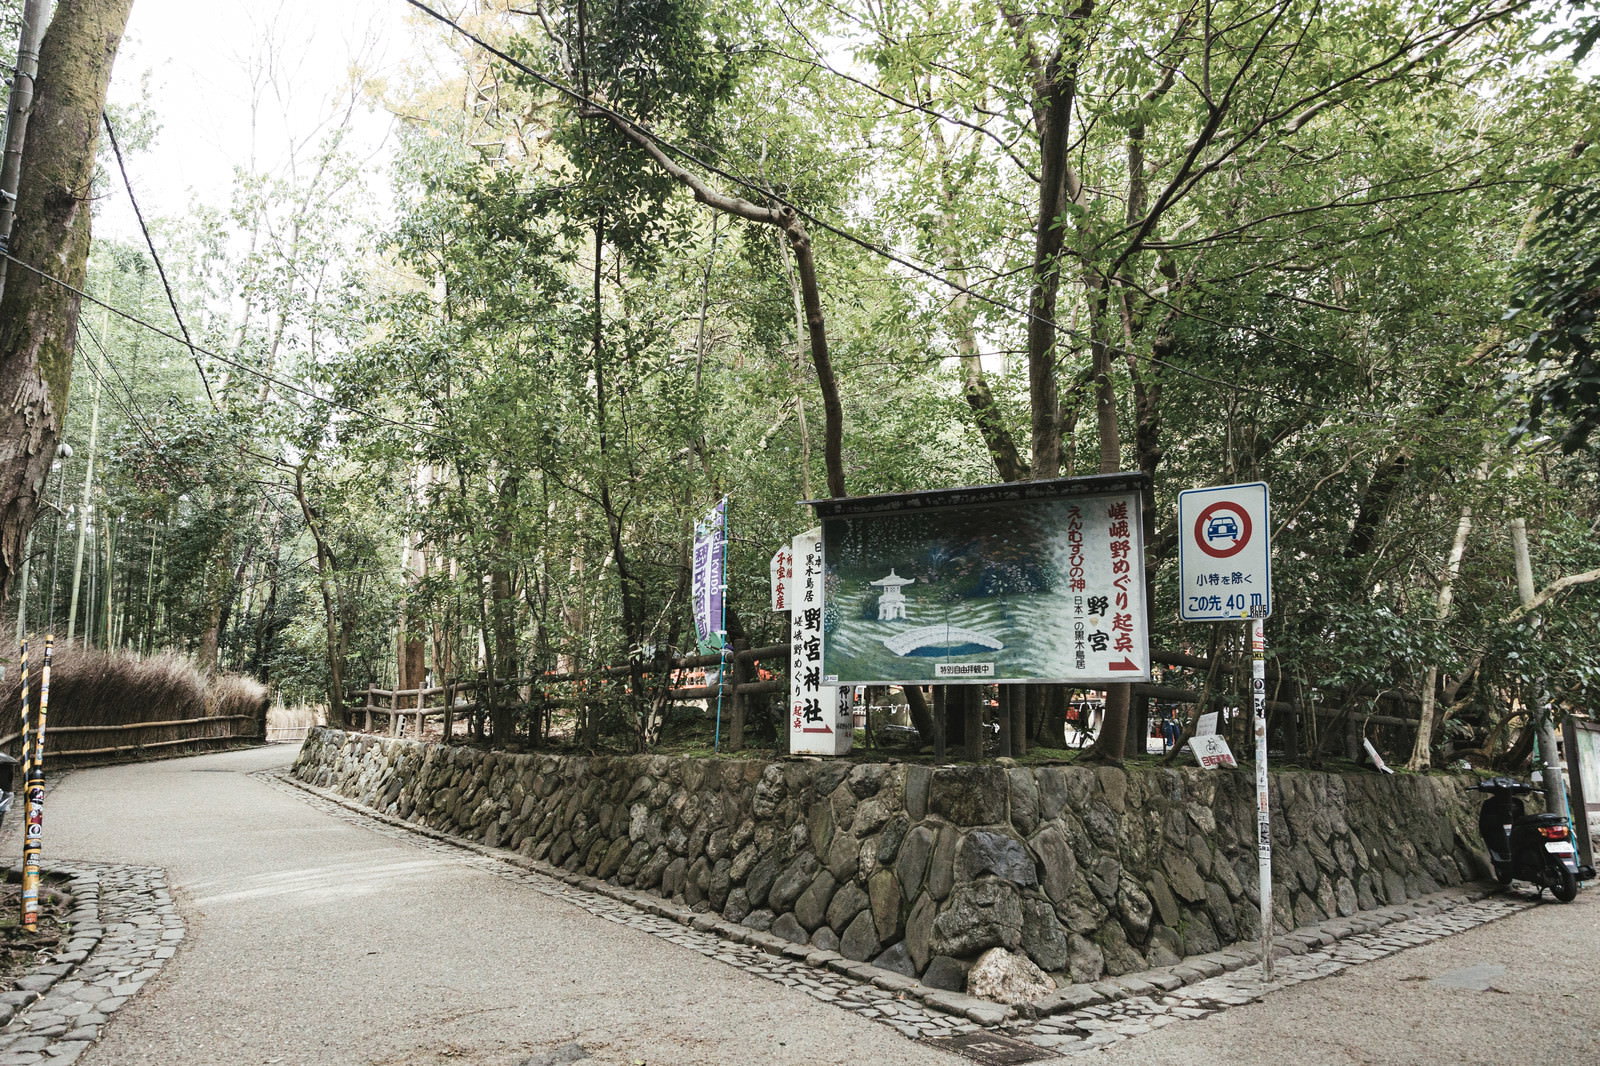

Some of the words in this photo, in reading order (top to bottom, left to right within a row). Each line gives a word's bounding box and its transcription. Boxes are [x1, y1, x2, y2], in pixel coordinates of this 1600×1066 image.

[1067, 505, 1086, 593] えんむすびの神
[803, 554, 814, 602] 黒木鳥居
[1108, 501, 1134, 653] 嵯峨野めぐり起点
[1188, 595, 1222, 611] この先
[1226, 594, 1245, 610] 40
[1196, 571, 1253, 587] 小特を除く
[1073, 595, 1086, 670] 日本一の黒木鳥居
[1087, 595, 1110, 653] 野宮
[803, 608, 823, 723] 野宮神社
[940, 665, 989, 674] 特別自由拝観中
[838, 686, 850, 717] 神社
